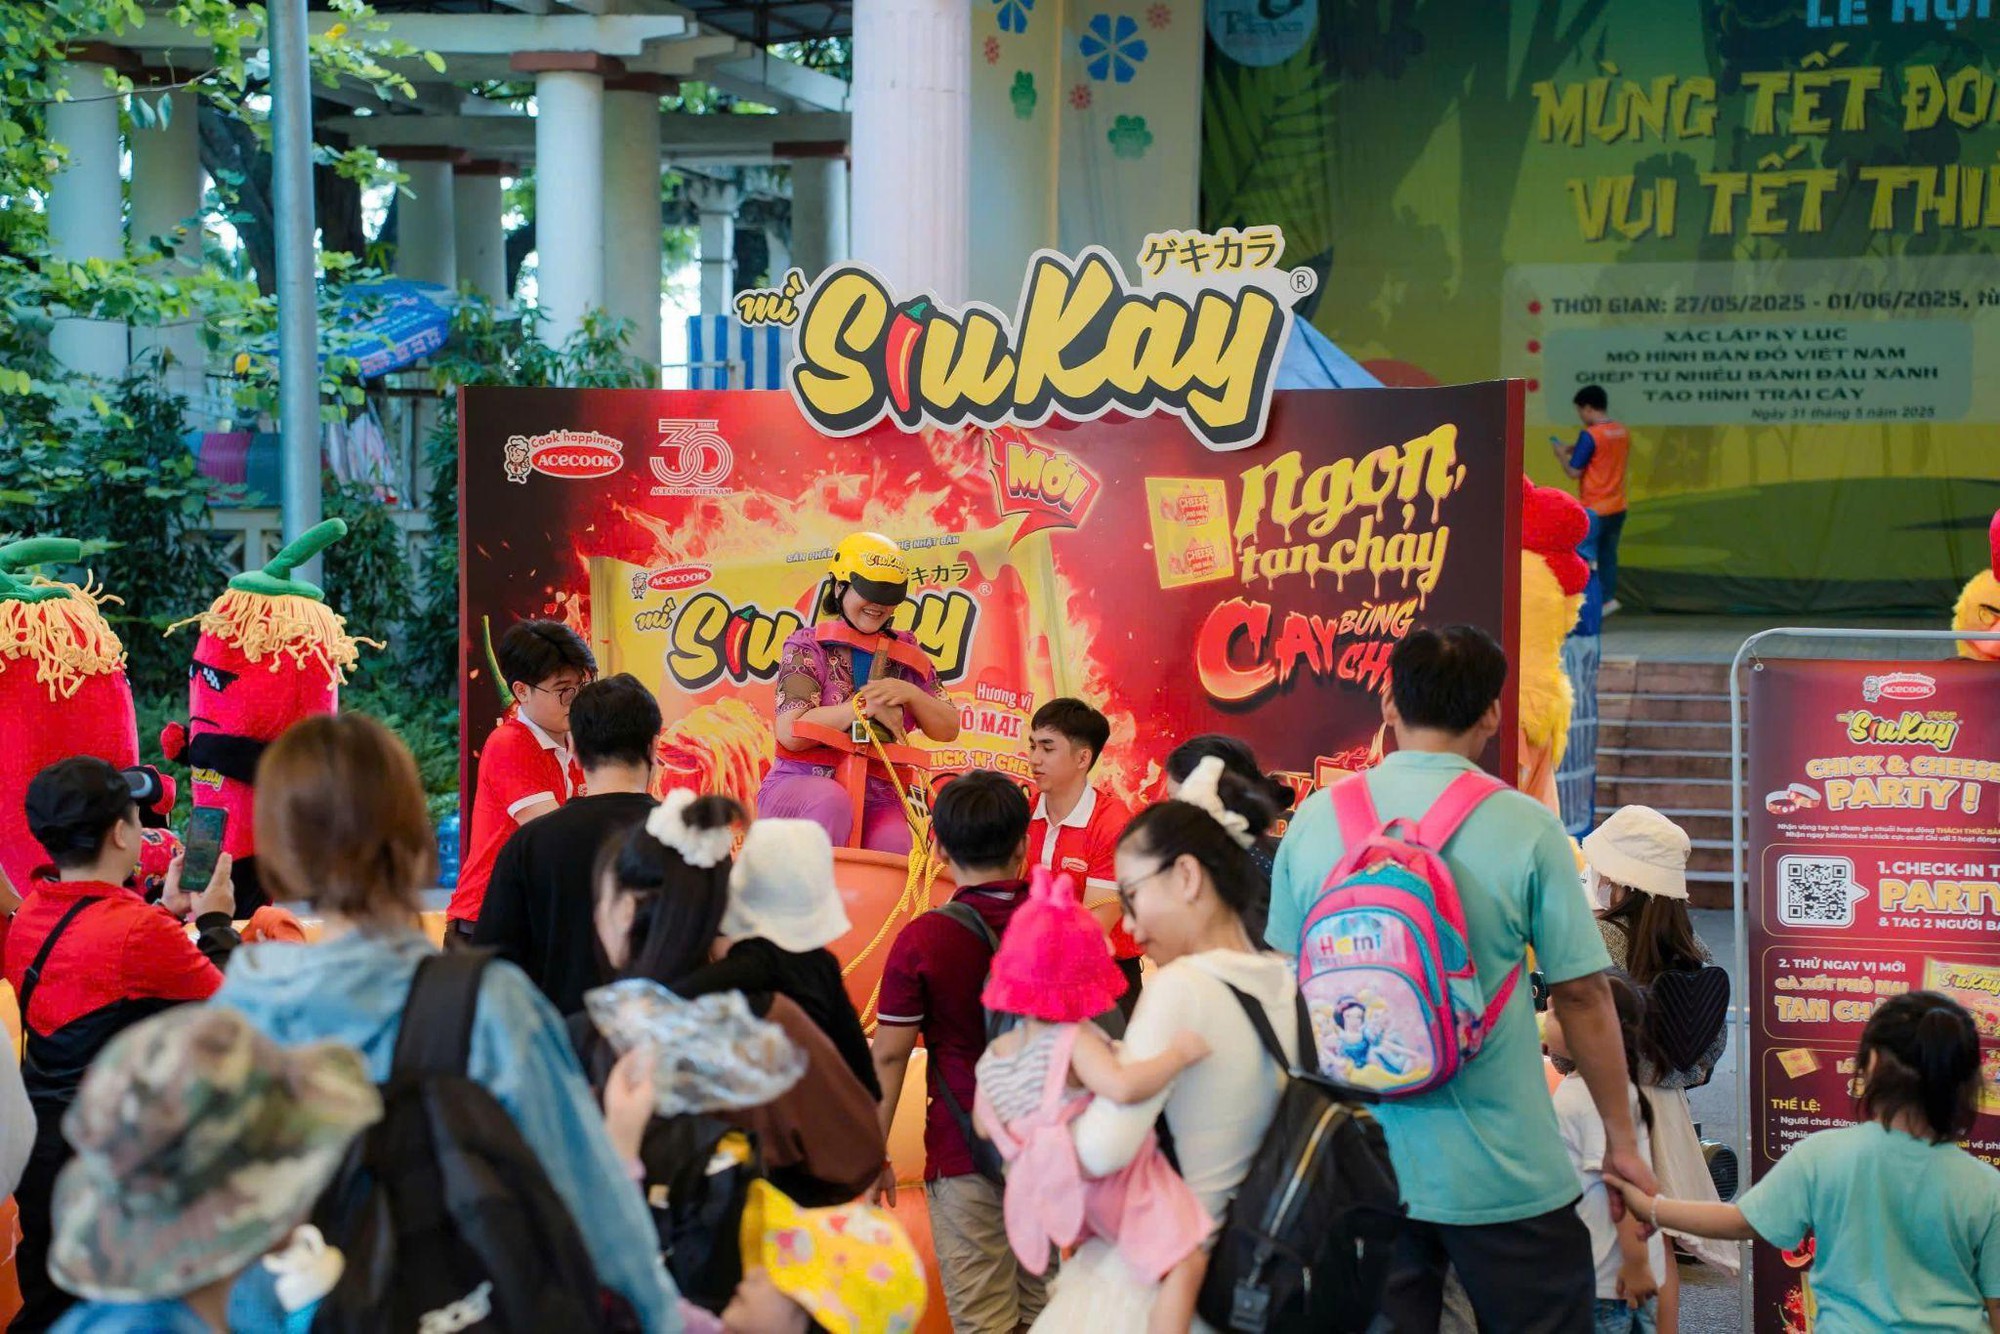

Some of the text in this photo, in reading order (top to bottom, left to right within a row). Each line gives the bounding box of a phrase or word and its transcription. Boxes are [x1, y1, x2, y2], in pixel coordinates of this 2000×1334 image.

[1741, 41, 1882, 135] TẾT
[1901, 64, 2000, 132] ĐO
[1567, 173, 1677, 242] VUI
[1700, 144, 1838, 236] TẾT
[1144, 231, 1276, 275] ゲキカラ
[1551, 294, 1600, 314] THỜI
[1608, 296, 1667, 314] GIAN:
[1674, 294, 1805, 313] 27/05/2025
[1828, 290, 1968, 311] 01/06/2025,
[1853, 347, 1906, 360] NAM
[531, 431, 621, 450] Cook happiness
[1239, 543, 1320, 589] tan
[1336, 599, 1418, 638] BÙNG
[1197, 597, 1339, 699] CAY
[980, 711, 1022, 738] MAI
[1806, 755, 1885, 779] CHICK
[1886, 755, 1909, 776] &
[1825, 777, 1960, 812] PARTY
[1877, 861, 1891, 874] 1.
[1892, 861, 1984, 877] CHECK-IN
[1878, 917, 1889, 927] &
[1892, 917, 1921, 928] TAG
[1923, 918, 1933, 928] 2
[1935, 917, 1982, 930] NGƯỜI
[1778, 957, 1906, 974] 2. THỬ NGAY VỊ MỚI
[1774, 995, 1831, 1023] TAN
